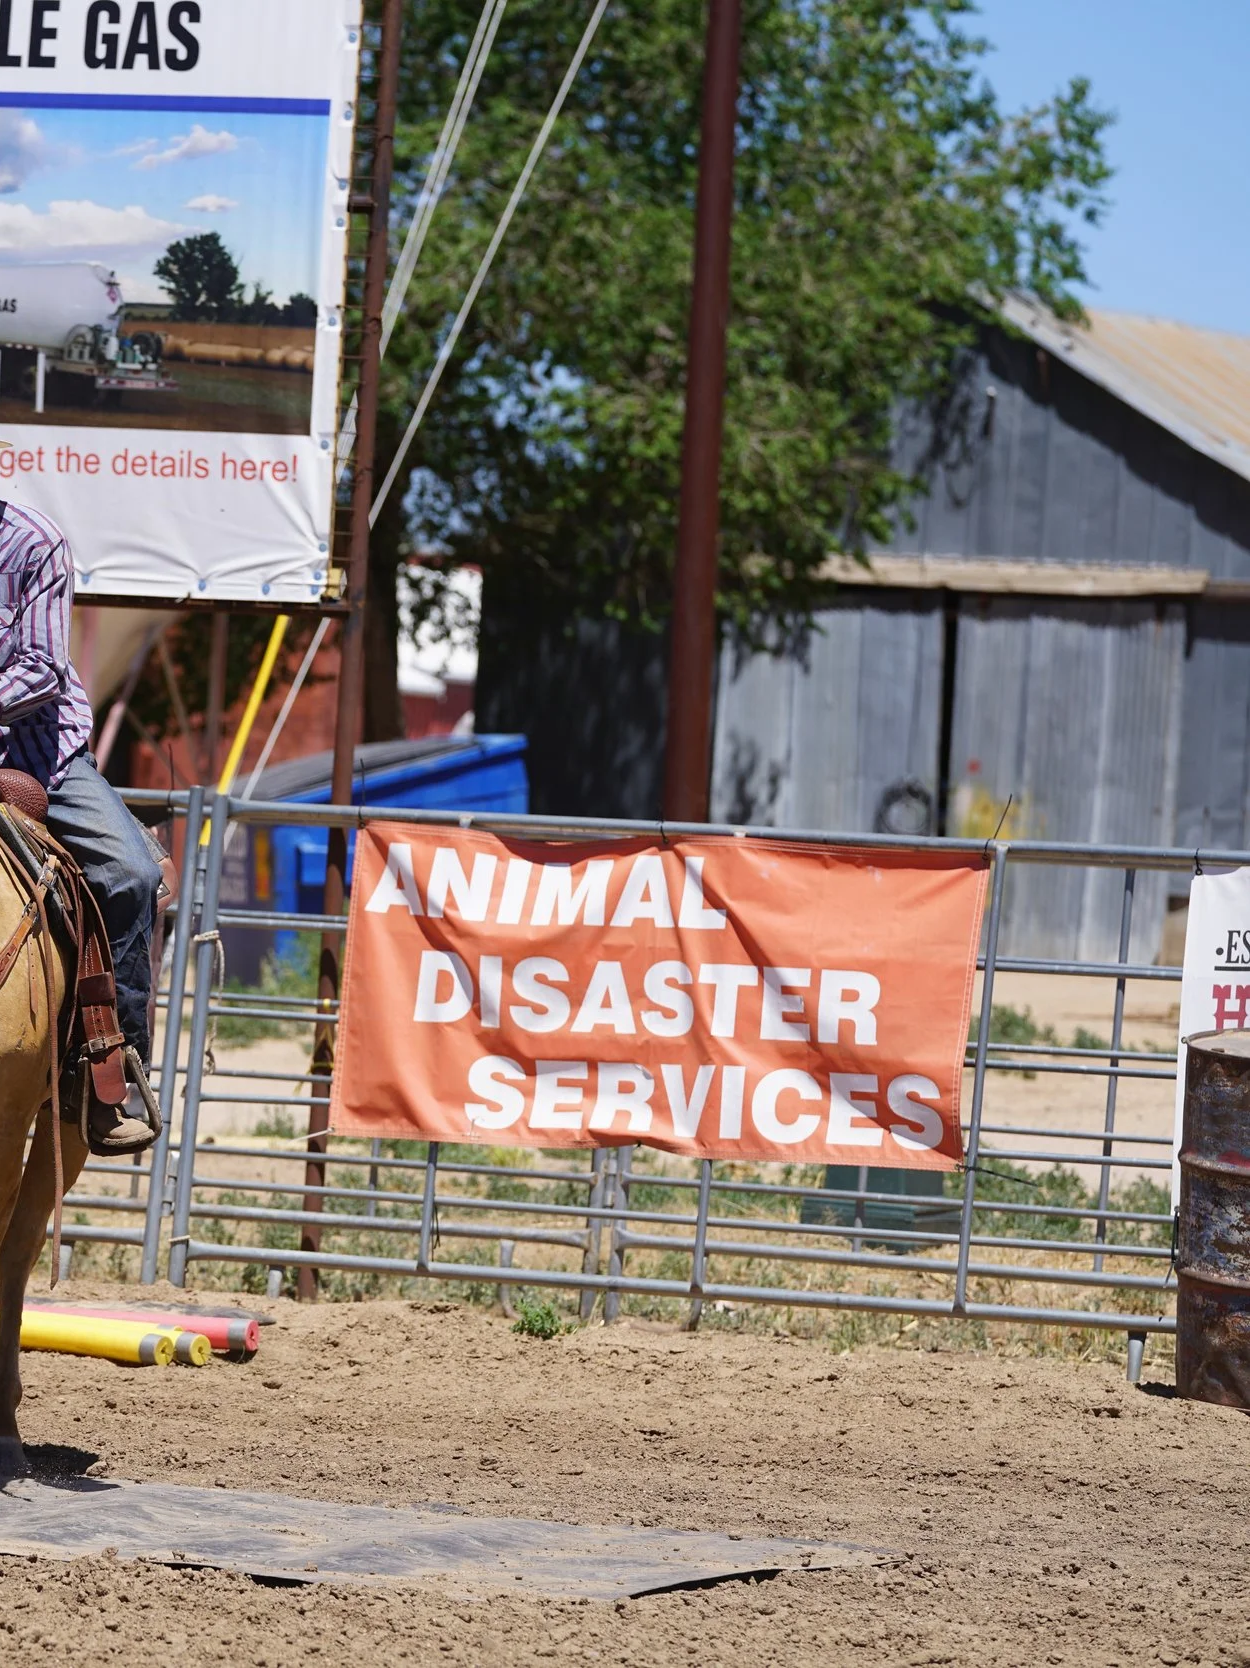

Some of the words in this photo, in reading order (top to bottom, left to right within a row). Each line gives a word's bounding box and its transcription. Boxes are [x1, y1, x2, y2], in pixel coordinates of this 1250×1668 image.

[82, 0, 201, 72] GAS
[56, 446, 101, 475] the
[111, 449, 210, 479] details
[221, 450, 299, 482] here!
[365, 842, 728, 930] ANIMAL
[413, 950, 882, 1046] DISASTER
[464, 1055, 945, 1151] SERVICES
